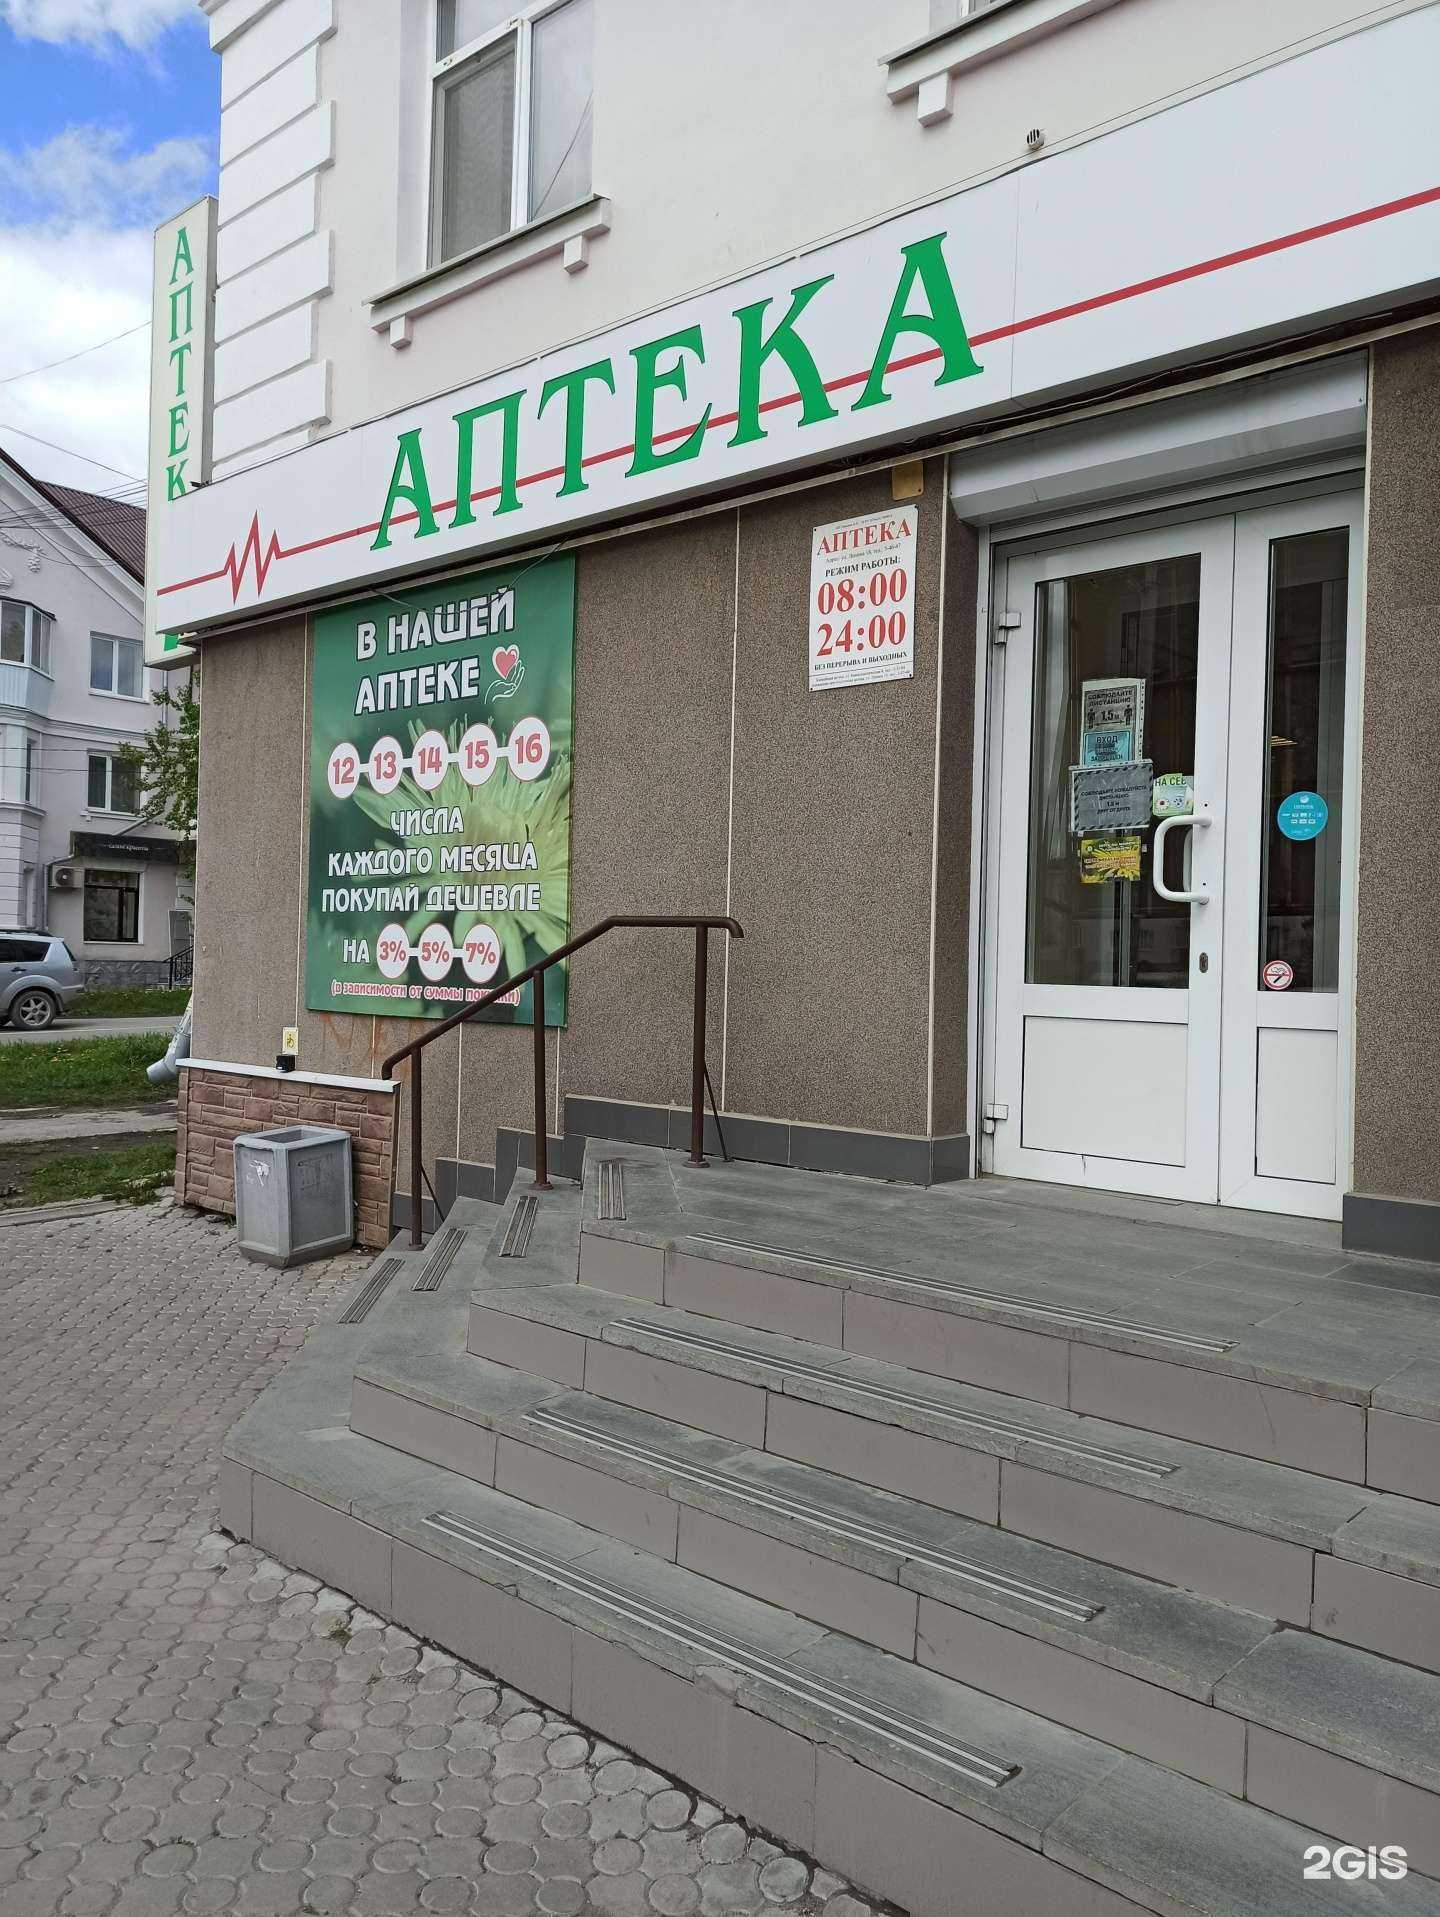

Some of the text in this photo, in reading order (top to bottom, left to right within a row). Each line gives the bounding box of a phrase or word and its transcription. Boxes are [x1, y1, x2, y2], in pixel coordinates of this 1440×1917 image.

[165, 226, 194, 500] АПТЕК
[370, 231, 985, 551] АПТЕКА
[817, 518, 911, 556] АПТЕКА
[825, 556, 901, 577] РЕЖИМ РАБОТЫ:
[818, 568, 907, 615] 08:00
[356, 586, 516, 661] В НАШЕЙ
[816, 611, 906, 656] 24:00
[814, 663, 826, 671] БЕЗ
[826, 659, 861, 670] ПЕРЕРЫВА
[868, 651, 908, 663] ВЫХОДНЫХ
[354, 655, 480, 716] АПТЕКЕ
[1096, 735, 1118, 743] ВХОД
[332, 733, 543, 785] 12 13 14 15 16
[1155, 778, 1167, 786] НА
[390, 806, 464, 838] ЧИСЛА
[328, 842, 538, 877] КАЖДОГО МЕСЯЦА
[321, 882, 541, 912] ПОКУПАЙ ДЕШЕВЛЕ
[343, 938, 496, 965] НА 3% 5% 7%
[331, 980, 521, 1007] (в зависимости от суммы покки)
